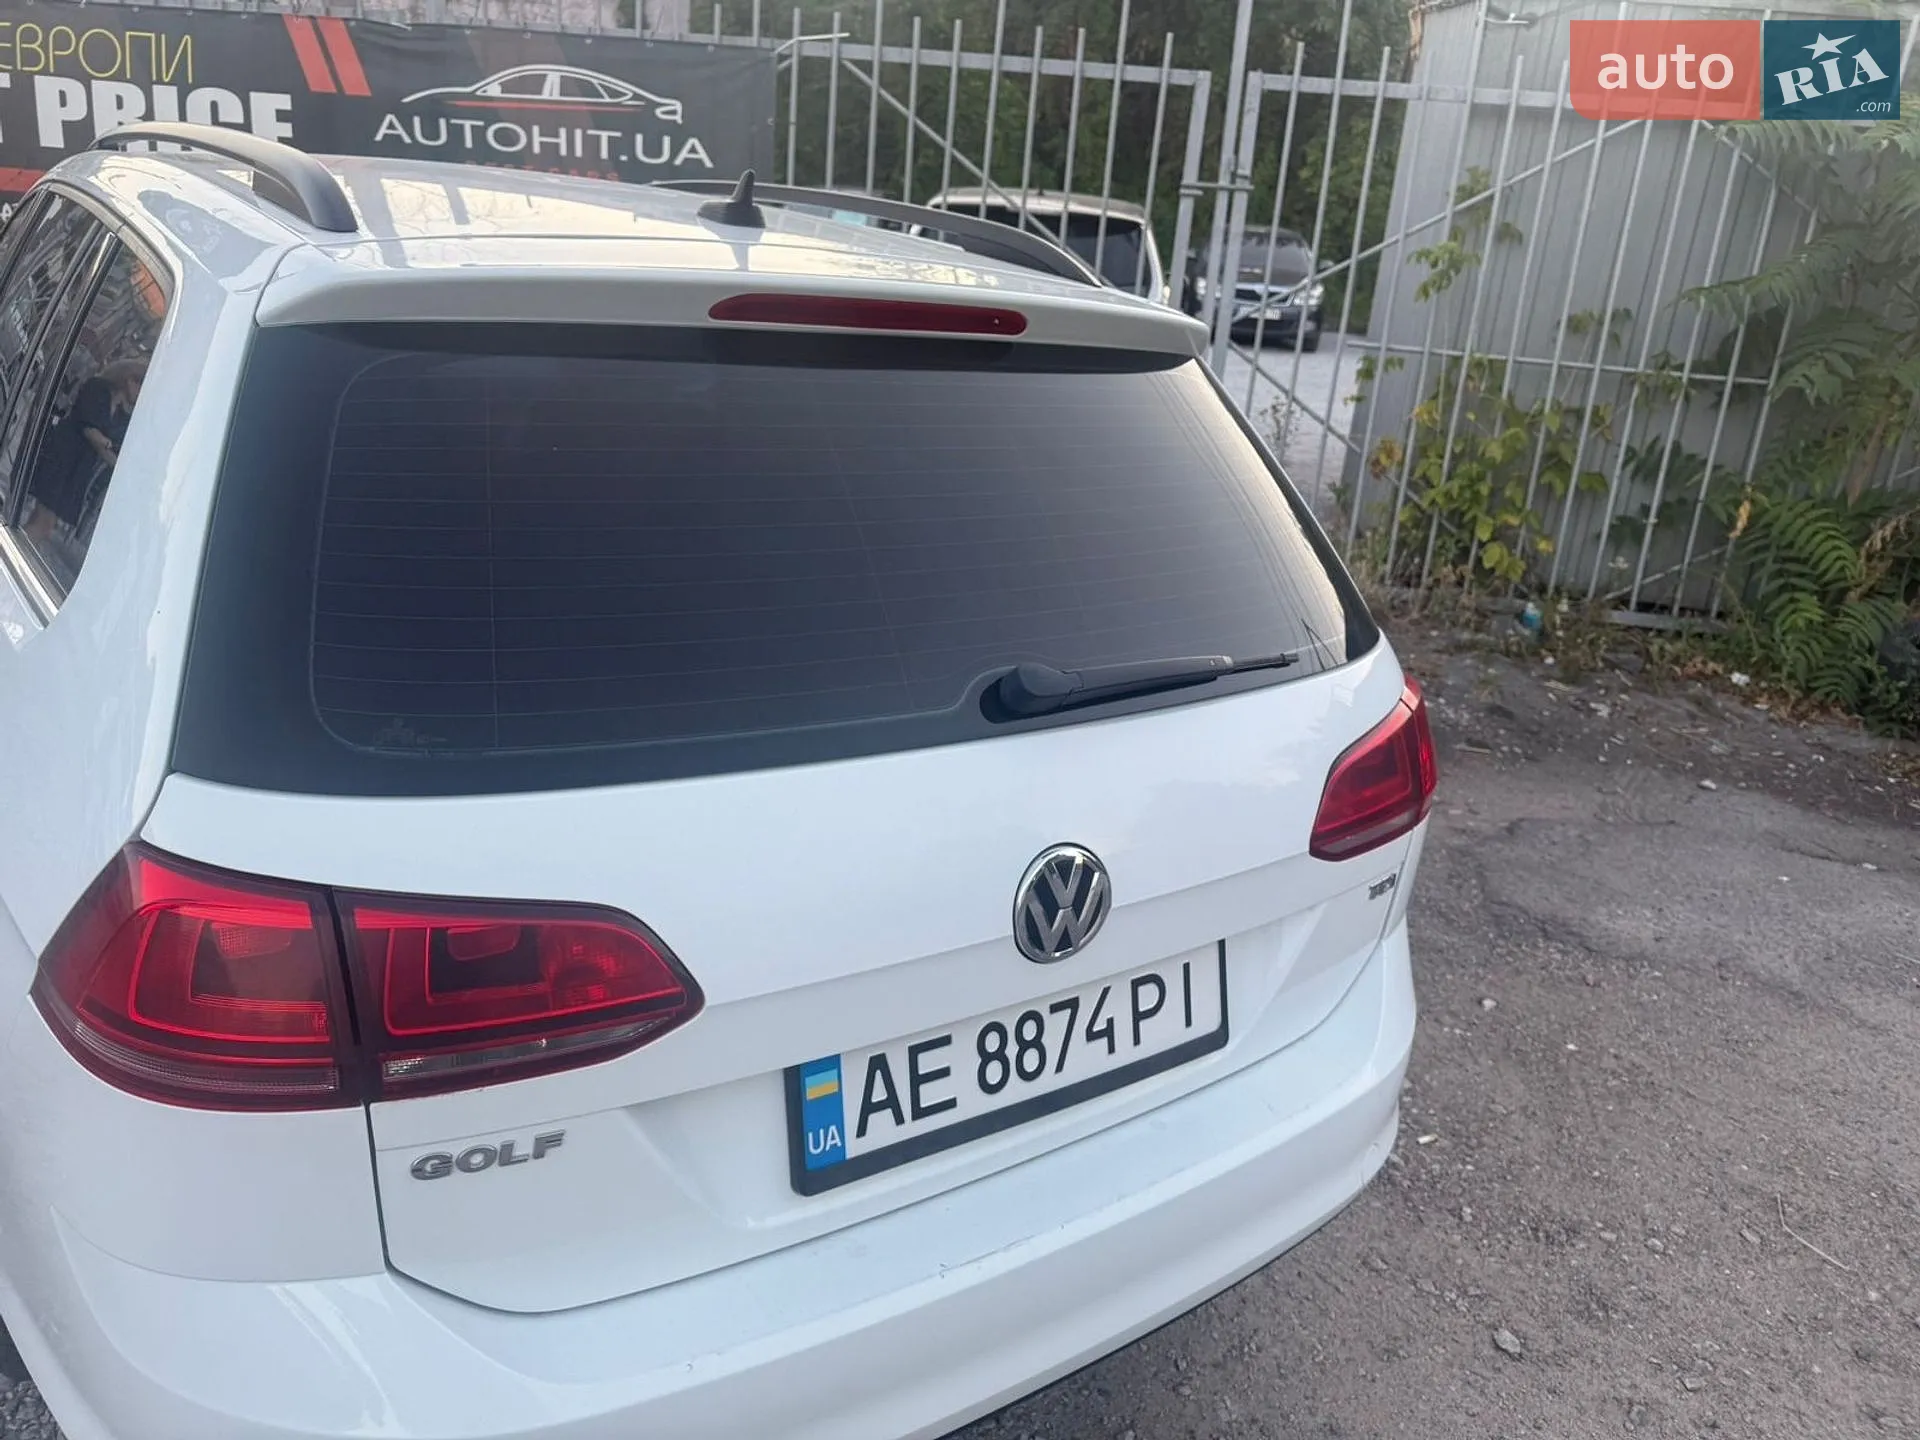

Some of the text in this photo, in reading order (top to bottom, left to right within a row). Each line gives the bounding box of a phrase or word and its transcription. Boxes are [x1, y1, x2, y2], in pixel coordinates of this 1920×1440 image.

[374, 112, 714, 168] AUTOHIT.UA
[855, 961, 1192, 1139] AE 8874 PI
[410, 1129, 566, 1181] GOLF
[808, 1128, 842, 1155] UA
